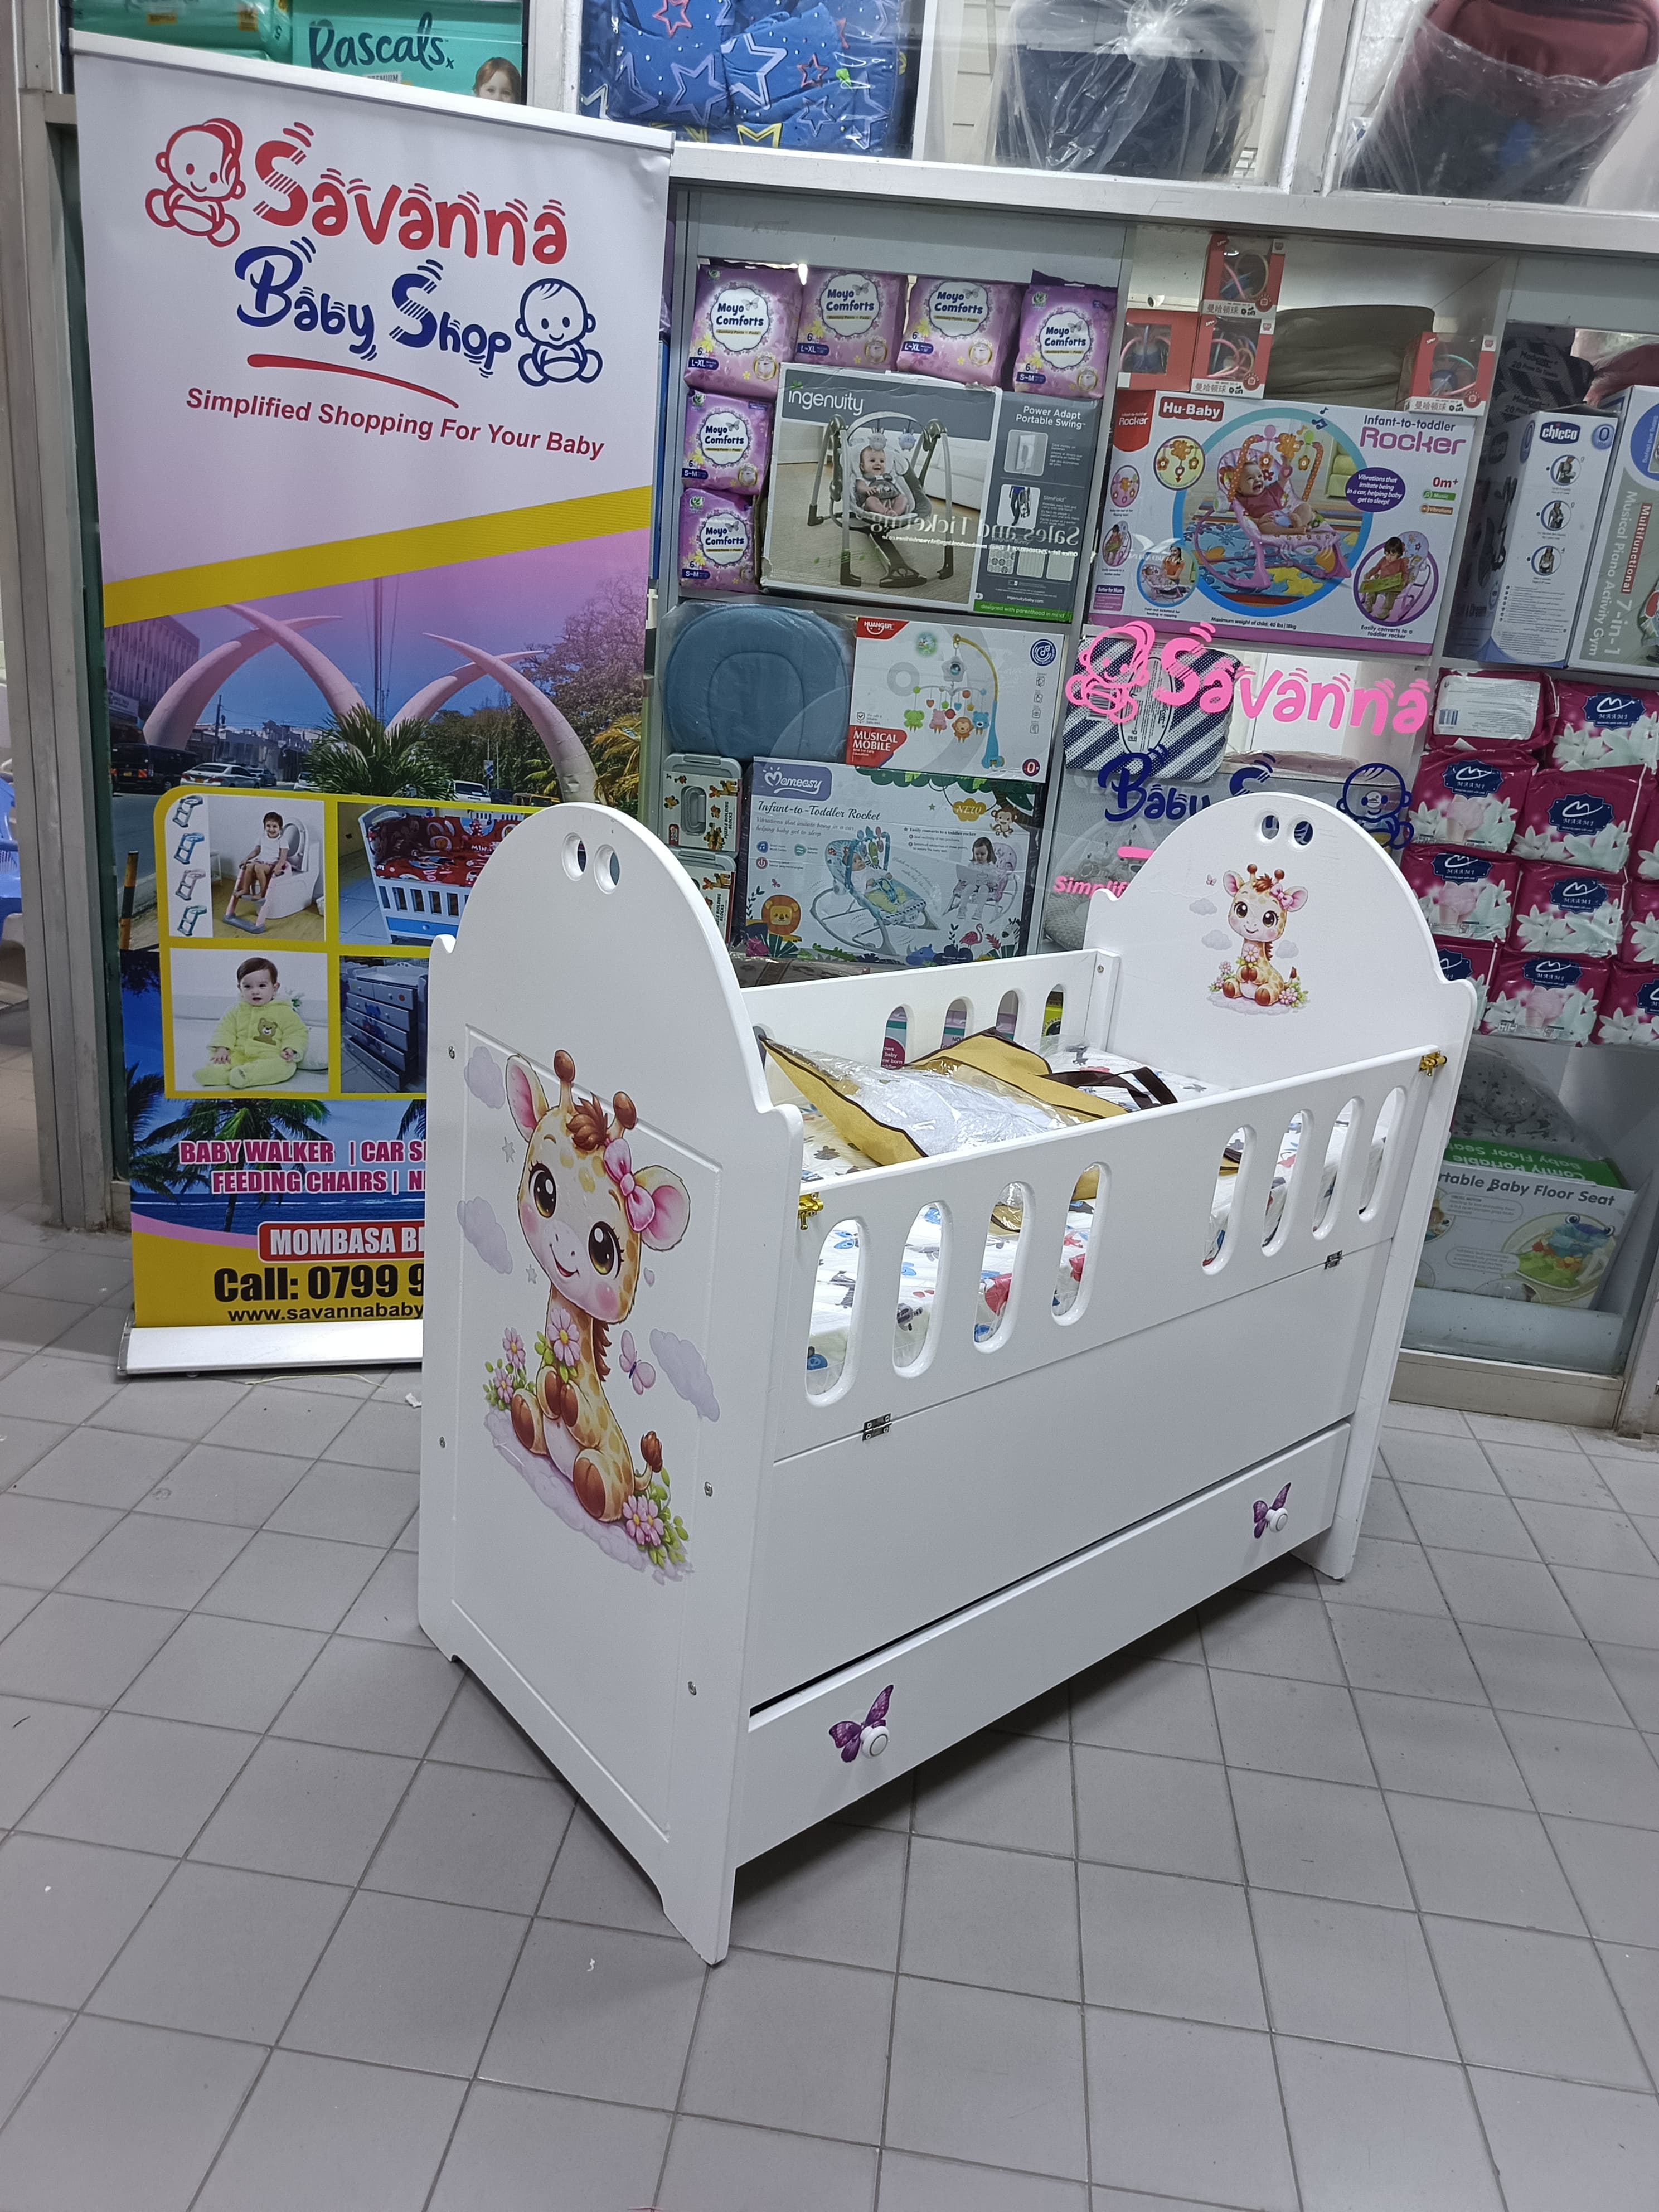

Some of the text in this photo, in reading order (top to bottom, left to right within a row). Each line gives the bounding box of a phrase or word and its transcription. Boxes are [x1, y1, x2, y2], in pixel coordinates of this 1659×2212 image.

[309, 12, 446, 71] Rascals
[367, 74, 399, 83] EMIUM
[253, 134, 567, 265] Savanna
[827, 289, 854, 301] Moyo
[937, 291, 964, 303] Moyo
[235, 245, 511, 369] Baby Shop
[717, 303, 744, 318] Moyo
[826, 302, 874, 312] Comforts
[934, 303, 983, 314] Comforts
[716, 315, 764, 326] Comforts
[1046, 326, 1069, 338] Moyo
[1045, 338, 1086, 347] Comforts
[788, 389, 864, 415] ingenuity
[1023, 405, 1081, 419] Power Adapt
[1163, 401, 1221, 419] Hu-Baby
[186, 387, 605, 461] Simplified Shopping For Your Baby
[1016, 414, 1052, 425] Portable
[1119, 416, 1149, 425] Rocker
[1364, 414, 1456, 431] Infant-to-toddler
[705, 426, 727, 436] Moyo
[1542, 424, 1578, 440] chicco
[705, 436, 744, 445] Comforts
[1359, 426, 1467, 454] Rocker
[1358, 474, 1385, 482] Vibrations
[1367, 490, 1388, 498] helping
[705, 527, 727, 537] Moyo
[705, 537, 744, 545] Comforts
[1587, 489, 1637, 656] Musical Piano Activity Gym
[1604, 505, 1650, 656] Multifunctional 7-in-1
[981, 604, 1003, 612] designed
[1016, 607, 1045, 617] parenthood
[864, 621, 893, 630] HUANGER
[1235, 618, 1251, 627] weight
[1361, 624, 1376, 633] Easily
[1153, 636, 1429, 735] Savanna
[853, 731, 898, 743] MUSICAL
[852, 740, 891, 751] MOBILE
[848, 808, 881, 821] Rocket
[956, 804, 982, 815] NEW
[1052, 875, 1130, 899] Simplif
[179, 1141, 426, 1164] BABY WALKER CAR S
[1493, 1148, 1533, 1162] Floor
[1453, 1154, 1525, 1172] Portable
[1540, 1154, 1582, 1171] Baby
[211, 1170, 425, 1194] FEEDING CHAIRS N
[1438, 1171, 1616, 1206] rtable Baby Floor Seat
[270, 1228, 396, 1257] MOMBASA
[214, 1267, 299, 1302] Call:
[307, 1264, 399, 1300] 0799
[227, 1302, 424, 1322] www.savannababy
